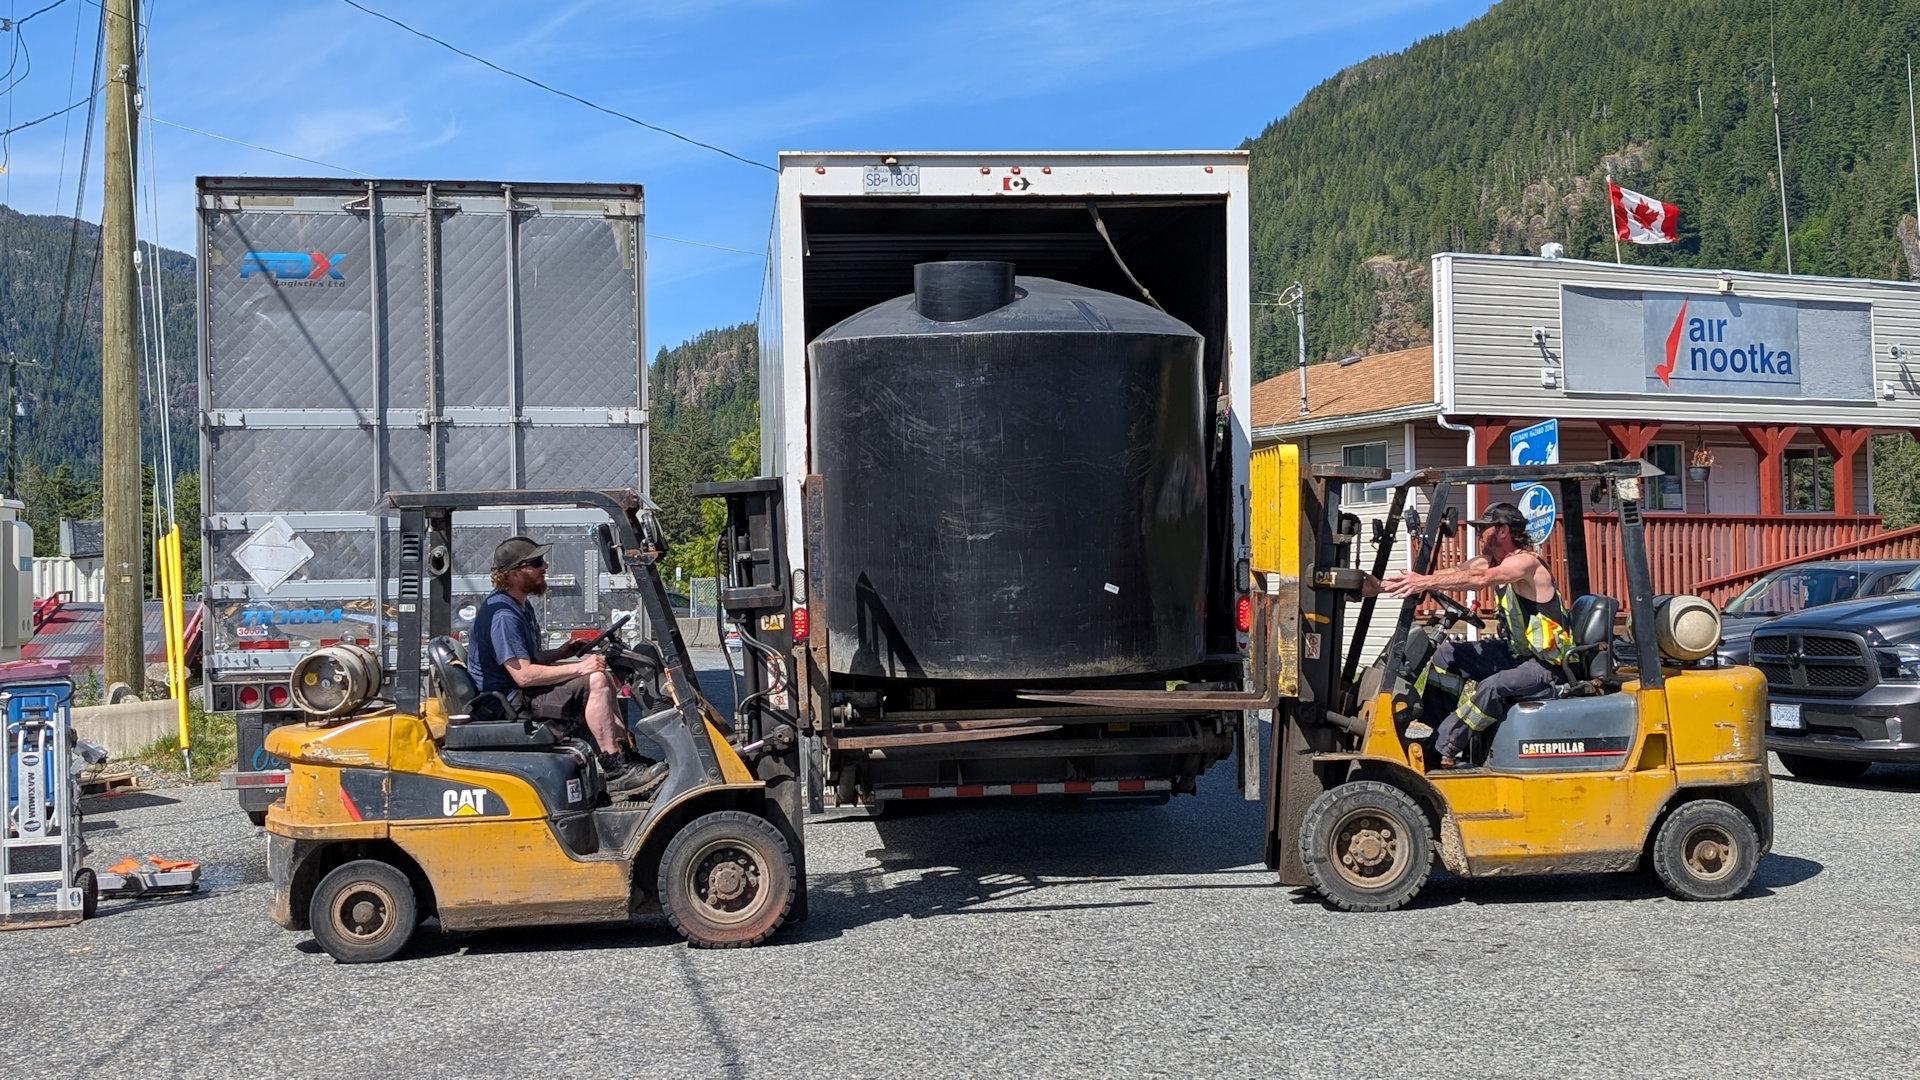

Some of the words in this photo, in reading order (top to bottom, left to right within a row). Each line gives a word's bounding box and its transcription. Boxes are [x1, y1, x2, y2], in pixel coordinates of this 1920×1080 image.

[866, 173, 881, 187] SB
[890, 173, 918, 187] 1800
[240, 252, 347, 280] PBX
[274, 279, 325, 288] Logistics
[327, 280, 346, 288] Ltd
[1689, 317, 1727, 343] air
[1691, 343, 1793, 375] nootka
[1513, 432, 1529, 442] TSUNAMI
[1529, 426, 1544, 437] HAZARD
[1544, 422, 1555, 433] ZONE
[1315, 571, 1338, 585] CAT
[760, 614, 786, 631] CAT
[1522, 742, 1584, 755] CATERPILLAR
[443, 789, 487, 817] CAT
